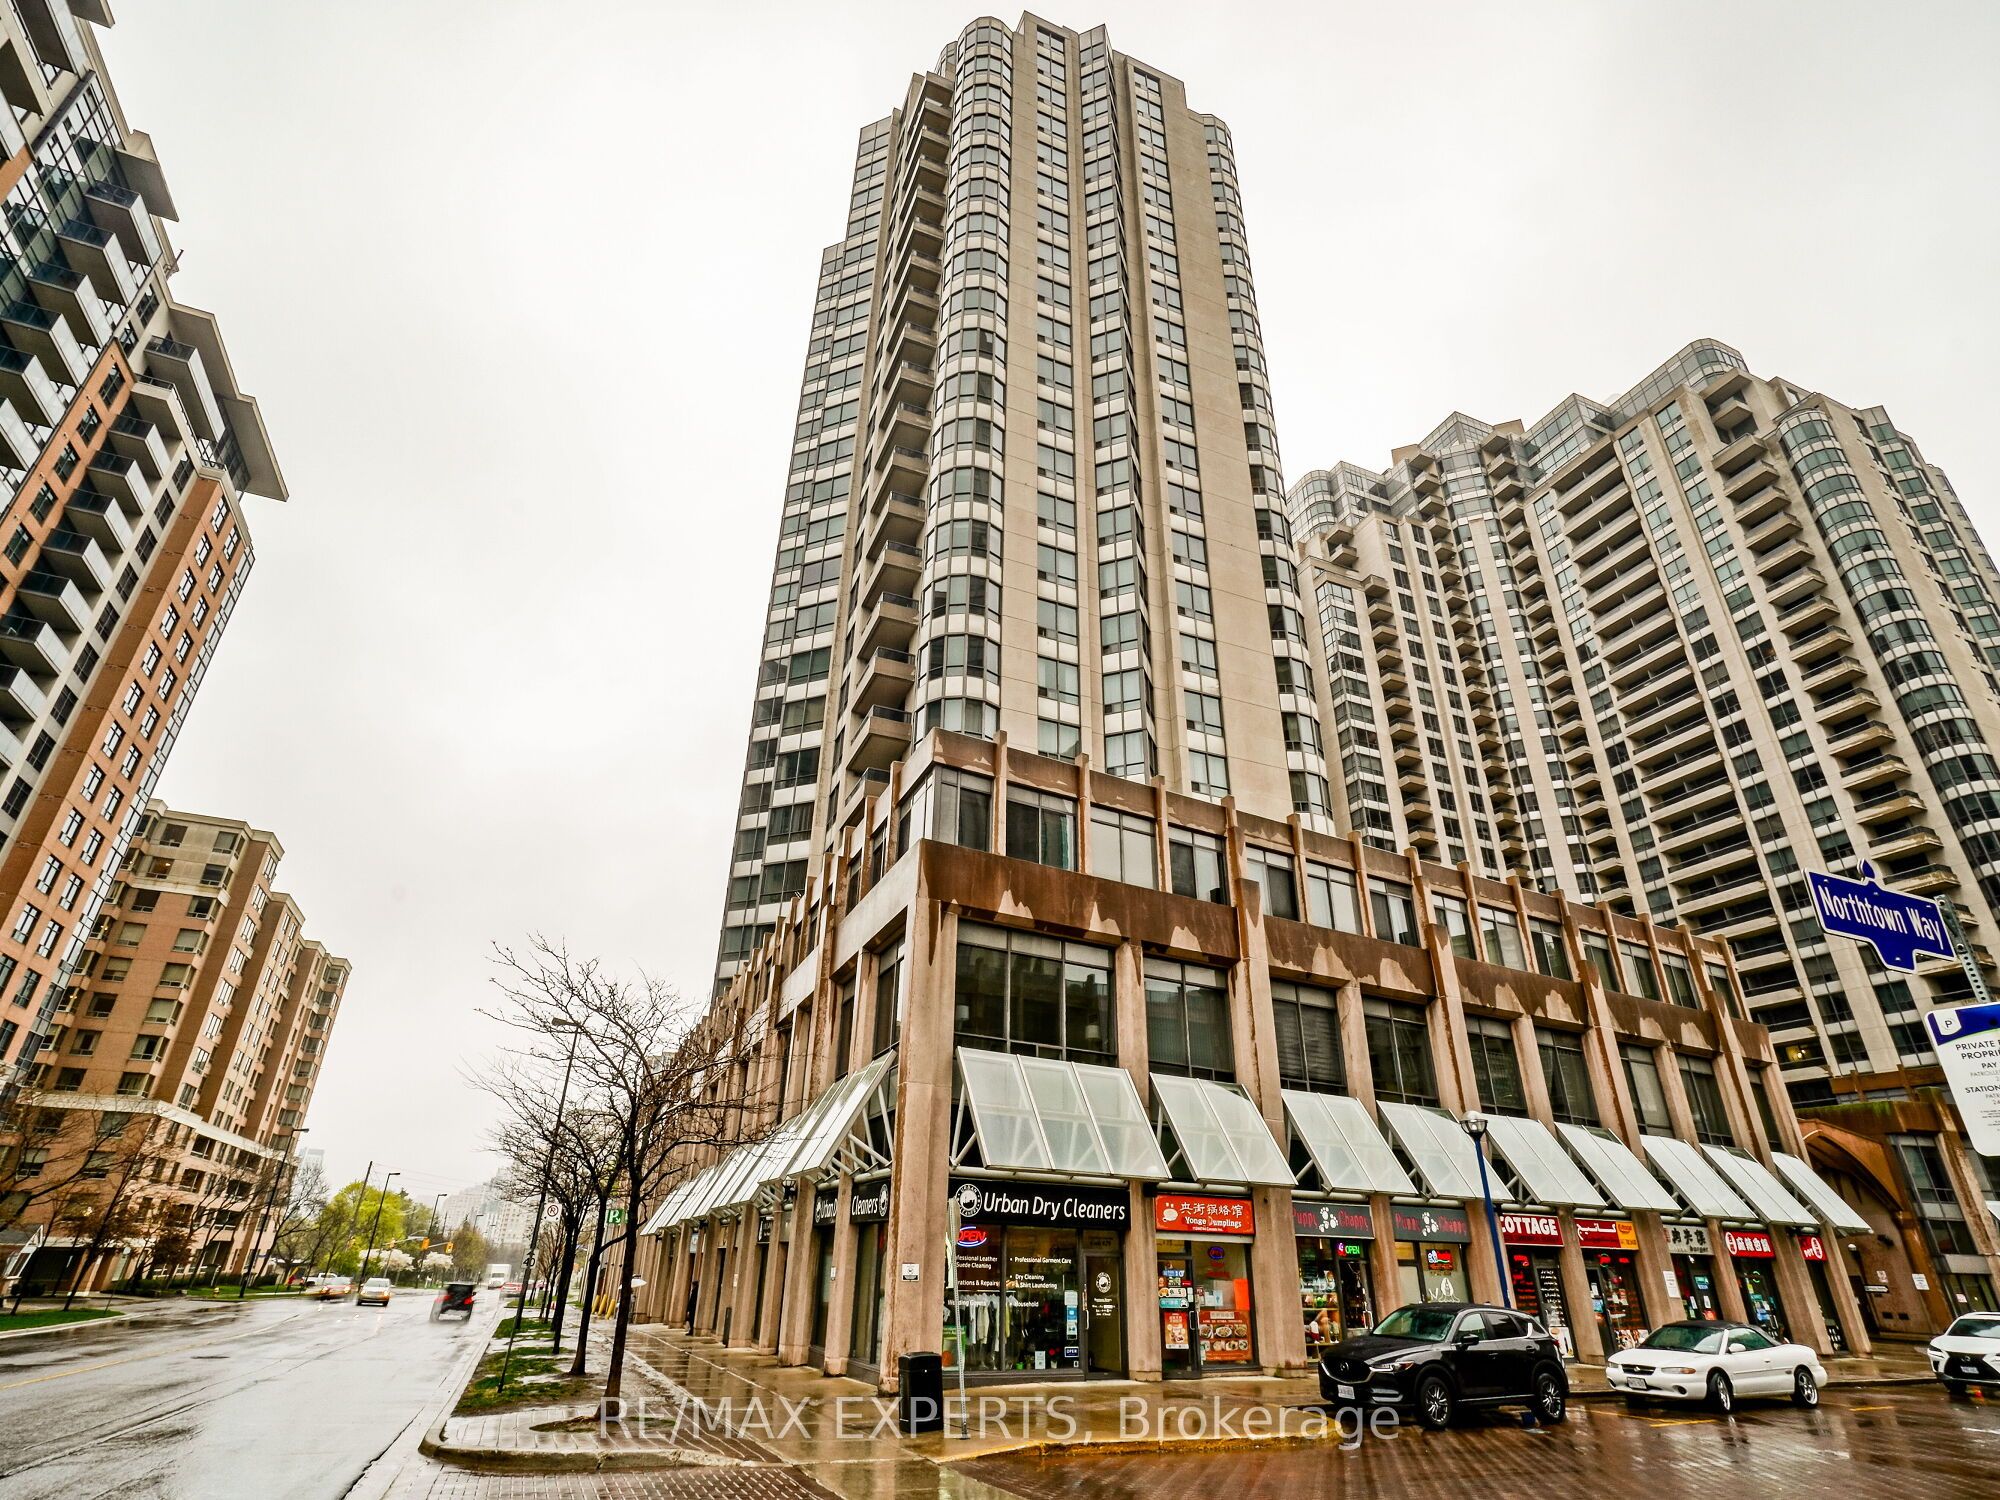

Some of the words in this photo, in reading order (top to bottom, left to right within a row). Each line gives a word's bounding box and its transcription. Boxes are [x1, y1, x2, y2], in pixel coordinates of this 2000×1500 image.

[1817, 884, 1908, 936] Northtown
[1906, 907, 1944, 950] Way
[1945, 1020, 1953, 1028] P
[1955, 1040, 1996, 1050] PRIVATE
[1981, 1061, 1998, 1069] PAY
[851, 1195, 879, 1216] Cleaners
[983, 1191, 1029, 1215] Urban
[1032, 1196, 1061, 1221] Dry
[1063, 1198, 1126, 1221] Cleaners
[1184, 1216, 1207, 1226] Yonge
[958, 1230, 987, 1242] OPEN
[1345, 1245, 1361, 1255] OPEN
[523, 1257, 536, 1267] 40
[979, 1255, 998, 1263] Leather
[1014, 1256, 1042, 1264] Professional
[1042, 1257, 1062, 1265] Garment
[1061, 1257, 1072, 1265] Care
[971, 1262, 992, 1270] Cleaning
[1031, 1282, 1058, 1290] Laundering
